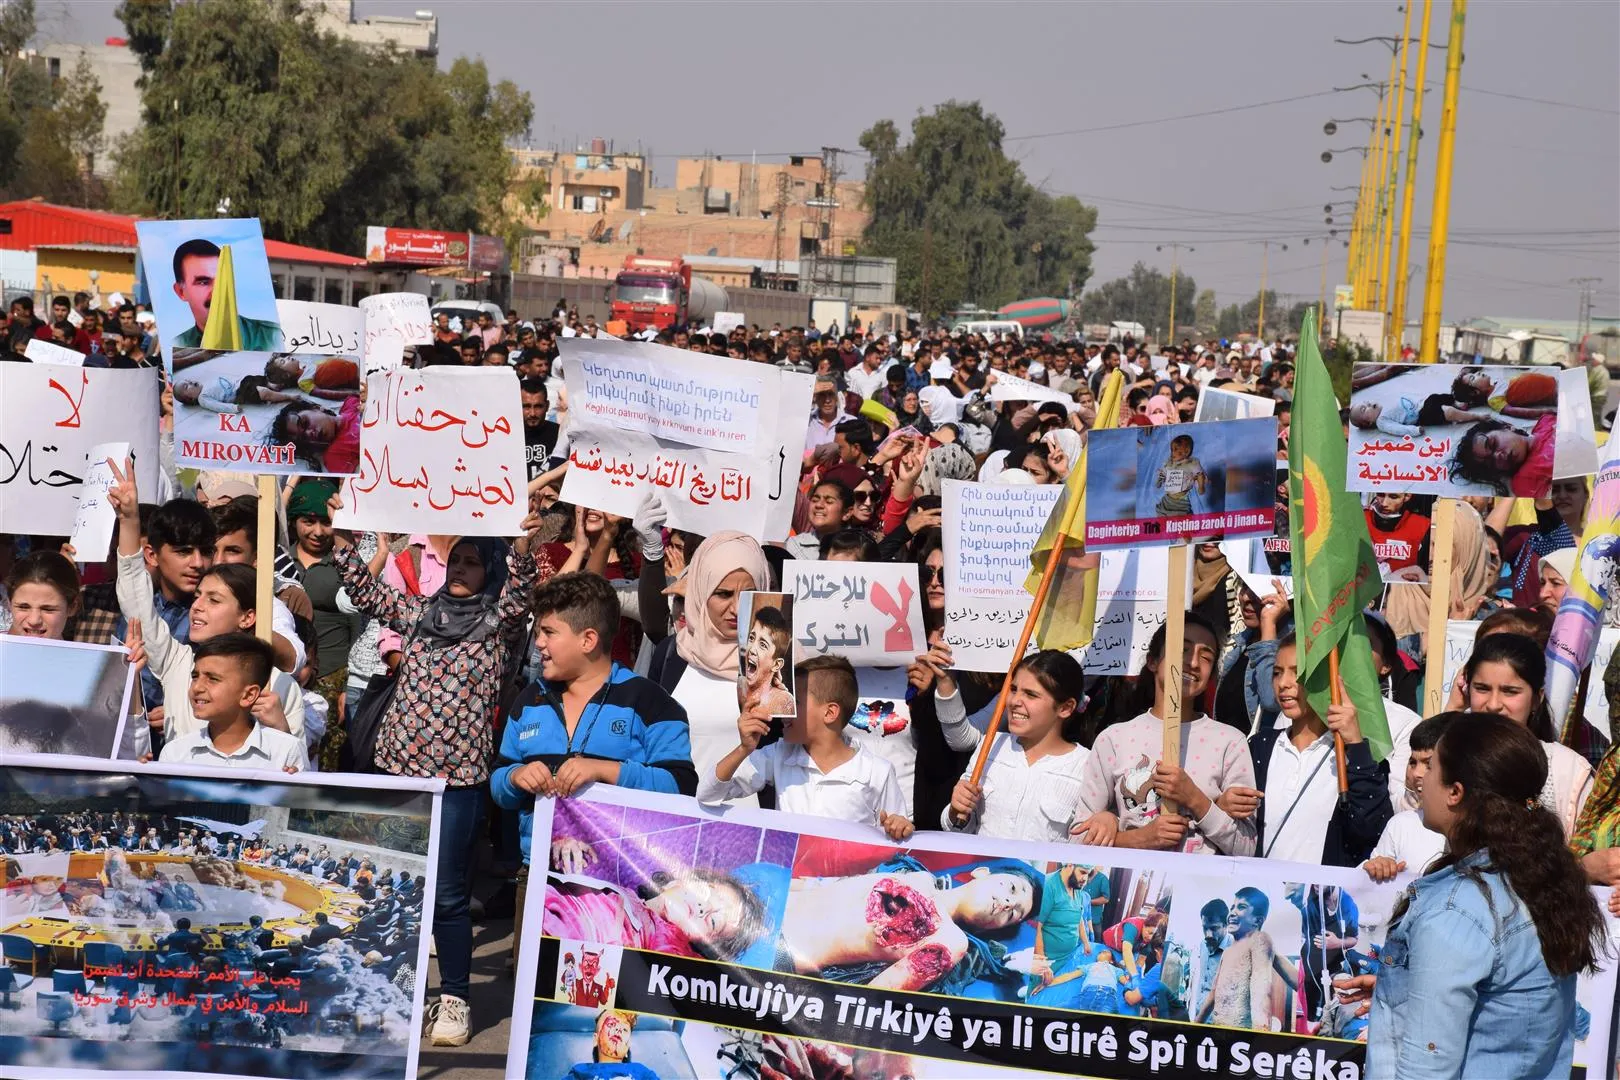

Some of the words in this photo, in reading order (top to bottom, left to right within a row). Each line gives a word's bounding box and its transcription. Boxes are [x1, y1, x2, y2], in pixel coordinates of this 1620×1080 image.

[49, 368, 88, 428] لا
[396, 376, 467, 431] حقنا
[219, 412, 252, 433] KA
[461, 409, 511, 448] من
[181, 440, 297, 465] MIROVATÎ
[1356, 435, 1416, 456] ضمير
[1358, 461, 1448, 485] الانسانية
[428, 457, 515, 518] نعيش
[1088, 521, 1140, 539] Dagirkeriya
[1166, 518, 1200, 535] Kuştina
[1201, 515, 1226, 529] zarok
[1234, 514, 1257, 528] jinan
[870, 576, 914, 652] لا
[82, 961, 124, 979] تضمن
[127, 959, 144, 979] أن
[147, 961, 200, 979] المتحدة
[204, 964, 240, 985] الأمم
[242, 970, 267, 987] على
[269, 972, 301, 991] يجب
[73, 988, 113, 1007] سوريا
[116, 992, 157, 1009] وشرق
[161, 992, 198, 1007] شمال
[201, 996, 213, 1015] في
[216, 995, 259, 1014] والأمن
[264, 999, 308, 1014] السلام
[647, 963, 825, 1023] Komkujîya
[835, 994, 953, 1044] Tirkiyê
[962, 1017, 1001, 1051] ya
[1012, 1015, 1033, 1049] li
[1043, 1017, 1118, 1058] Girê
[1128, 1029, 1186, 1073] Spî
[1196, 1034, 1219, 1072] û
[1229, 1042, 1366, 1080] Serêka
